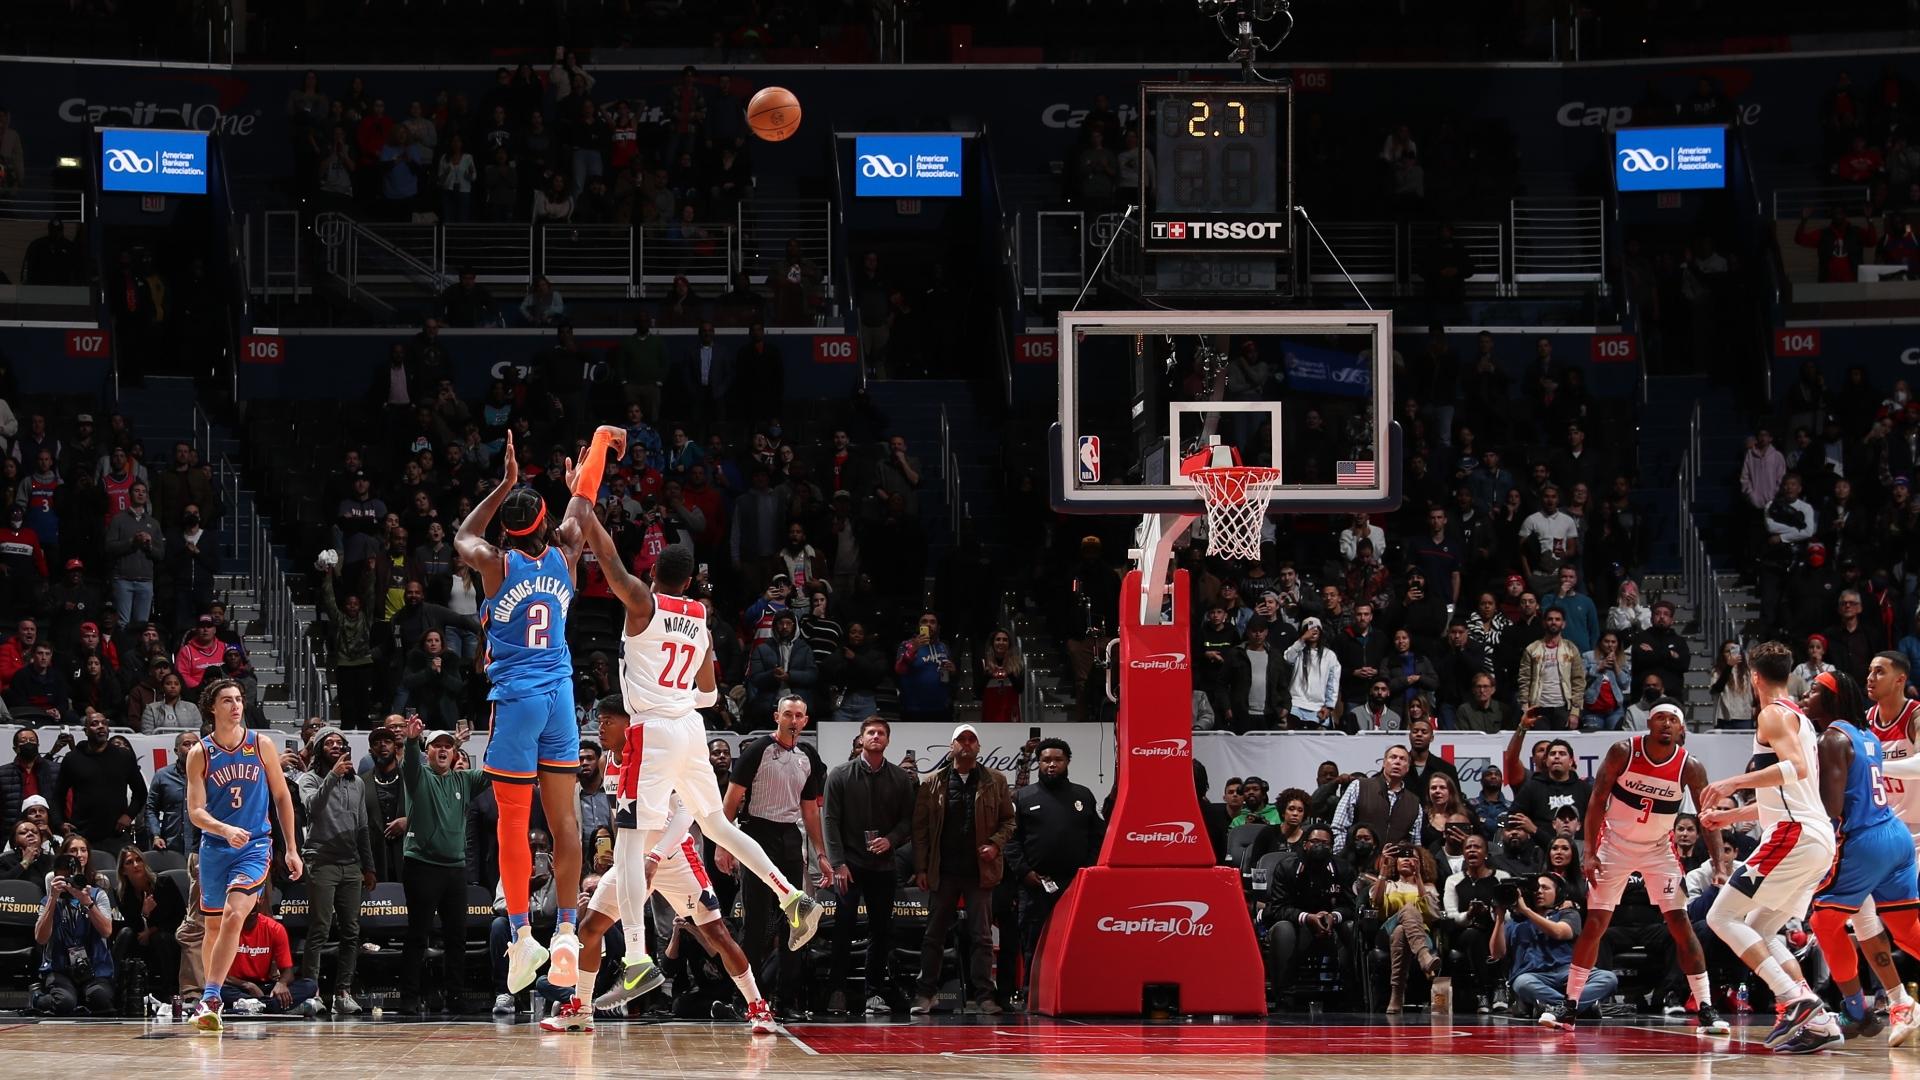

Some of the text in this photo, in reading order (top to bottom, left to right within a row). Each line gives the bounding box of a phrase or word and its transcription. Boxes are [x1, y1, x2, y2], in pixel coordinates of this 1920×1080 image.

[1300, 73, 1327, 88] 105
[1189, 101, 1246, 137] 2.7
[162, 151, 195, 160] American
[916, 155, 949, 163] American
[1677, 147, 1712, 156] American
[1677, 155, 1707, 163] Bankers
[162, 159, 190, 168] Bankers
[916, 162, 945, 170] Bankers
[1188, 222, 1283, 240] TISSOT
[73, 336, 102, 352] 107
[248, 342, 279, 358] 106
[820, 341, 852, 358] 106
[1022, 341, 1053, 358] 105
[1598, 341, 1630, 357] 105
[1781, 335, 1814, 352] 104
[1081, 471, 1093, 480] NBA
[527, 602, 550, 649] 2
[664, 617, 700, 640] MORRIS
[658, 641, 696, 690] 22
[1881, 746, 1907, 760] ards
[210, 763, 260, 787] THUNDER
[1625, 779, 1677, 798] wizards
[1870, 765, 1887, 807] 5
[230, 785, 243, 809] 3
[1637, 797, 1654, 824] 3
[0, 902, 40, 913] TSBOOK
[279, 906, 309, 915] SPORT
[360, 906, 408, 916] PORTSBO
